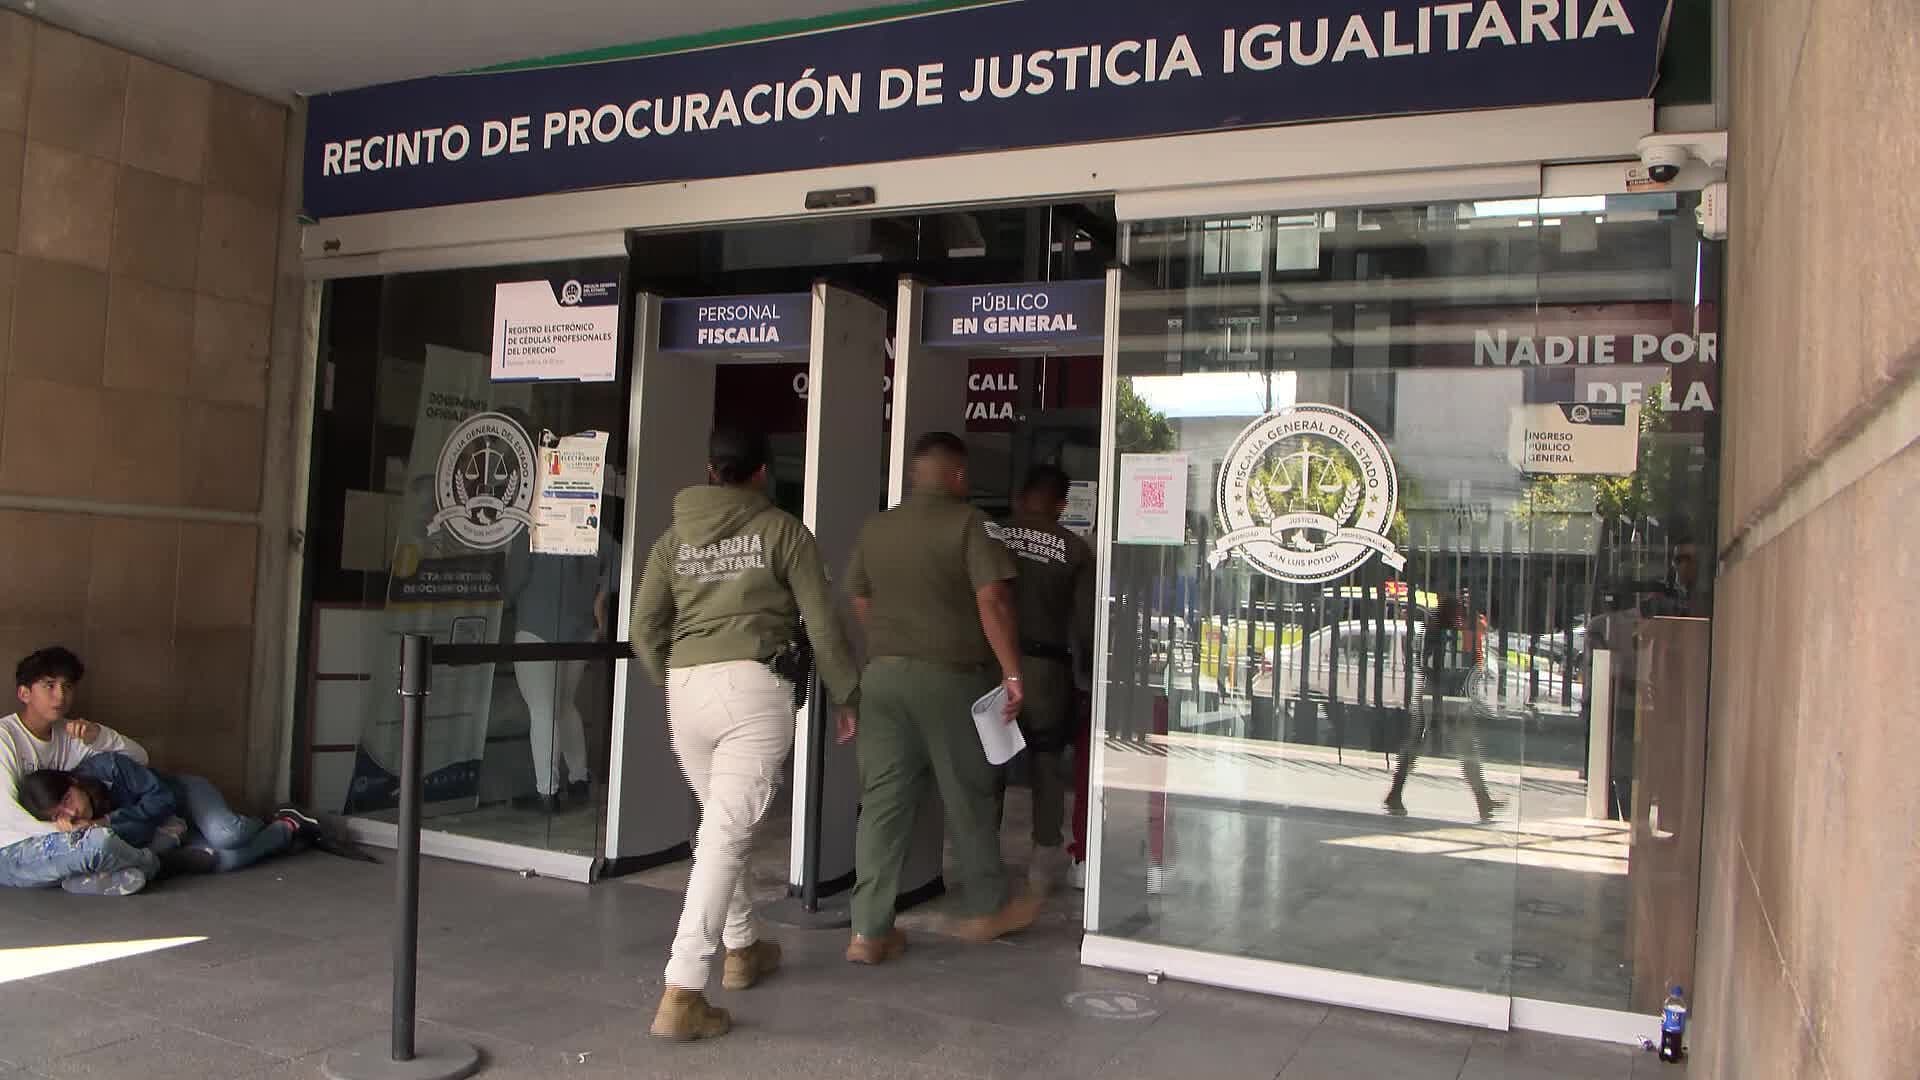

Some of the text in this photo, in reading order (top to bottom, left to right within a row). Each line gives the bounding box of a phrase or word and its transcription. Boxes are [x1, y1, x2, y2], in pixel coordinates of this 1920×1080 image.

[322, 0, 1635, 177] RECINTO DE PROCURACIÓN DE JUSTICIA IGUALITARIA
[971, 292, 1049, 313] PÚBLICO
[698, 304, 781, 323] PERSONAL
[508, 322, 595, 335] REGISTRO ELECTRÓNICO
[952, 313, 1078, 335] EN GENERAL
[508, 332, 613, 346] DE CÉDULAS PROFESIONALES
[697, 324, 780, 345] FISCALÍA
[507, 346, 557, 356] DEL DERECHO
[1474, 329, 1617, 366] NADIE
[1660, 380, 1715, 412] LA
[1529, 431, 1574, 441] INGRESO
[1235, 420, 1379, 489] FISCALÍA GENERAL DEL ESTADO
[1528, 453, 1575, 463] GENERAL
[1286, 556, 1306, 567] LUIS
